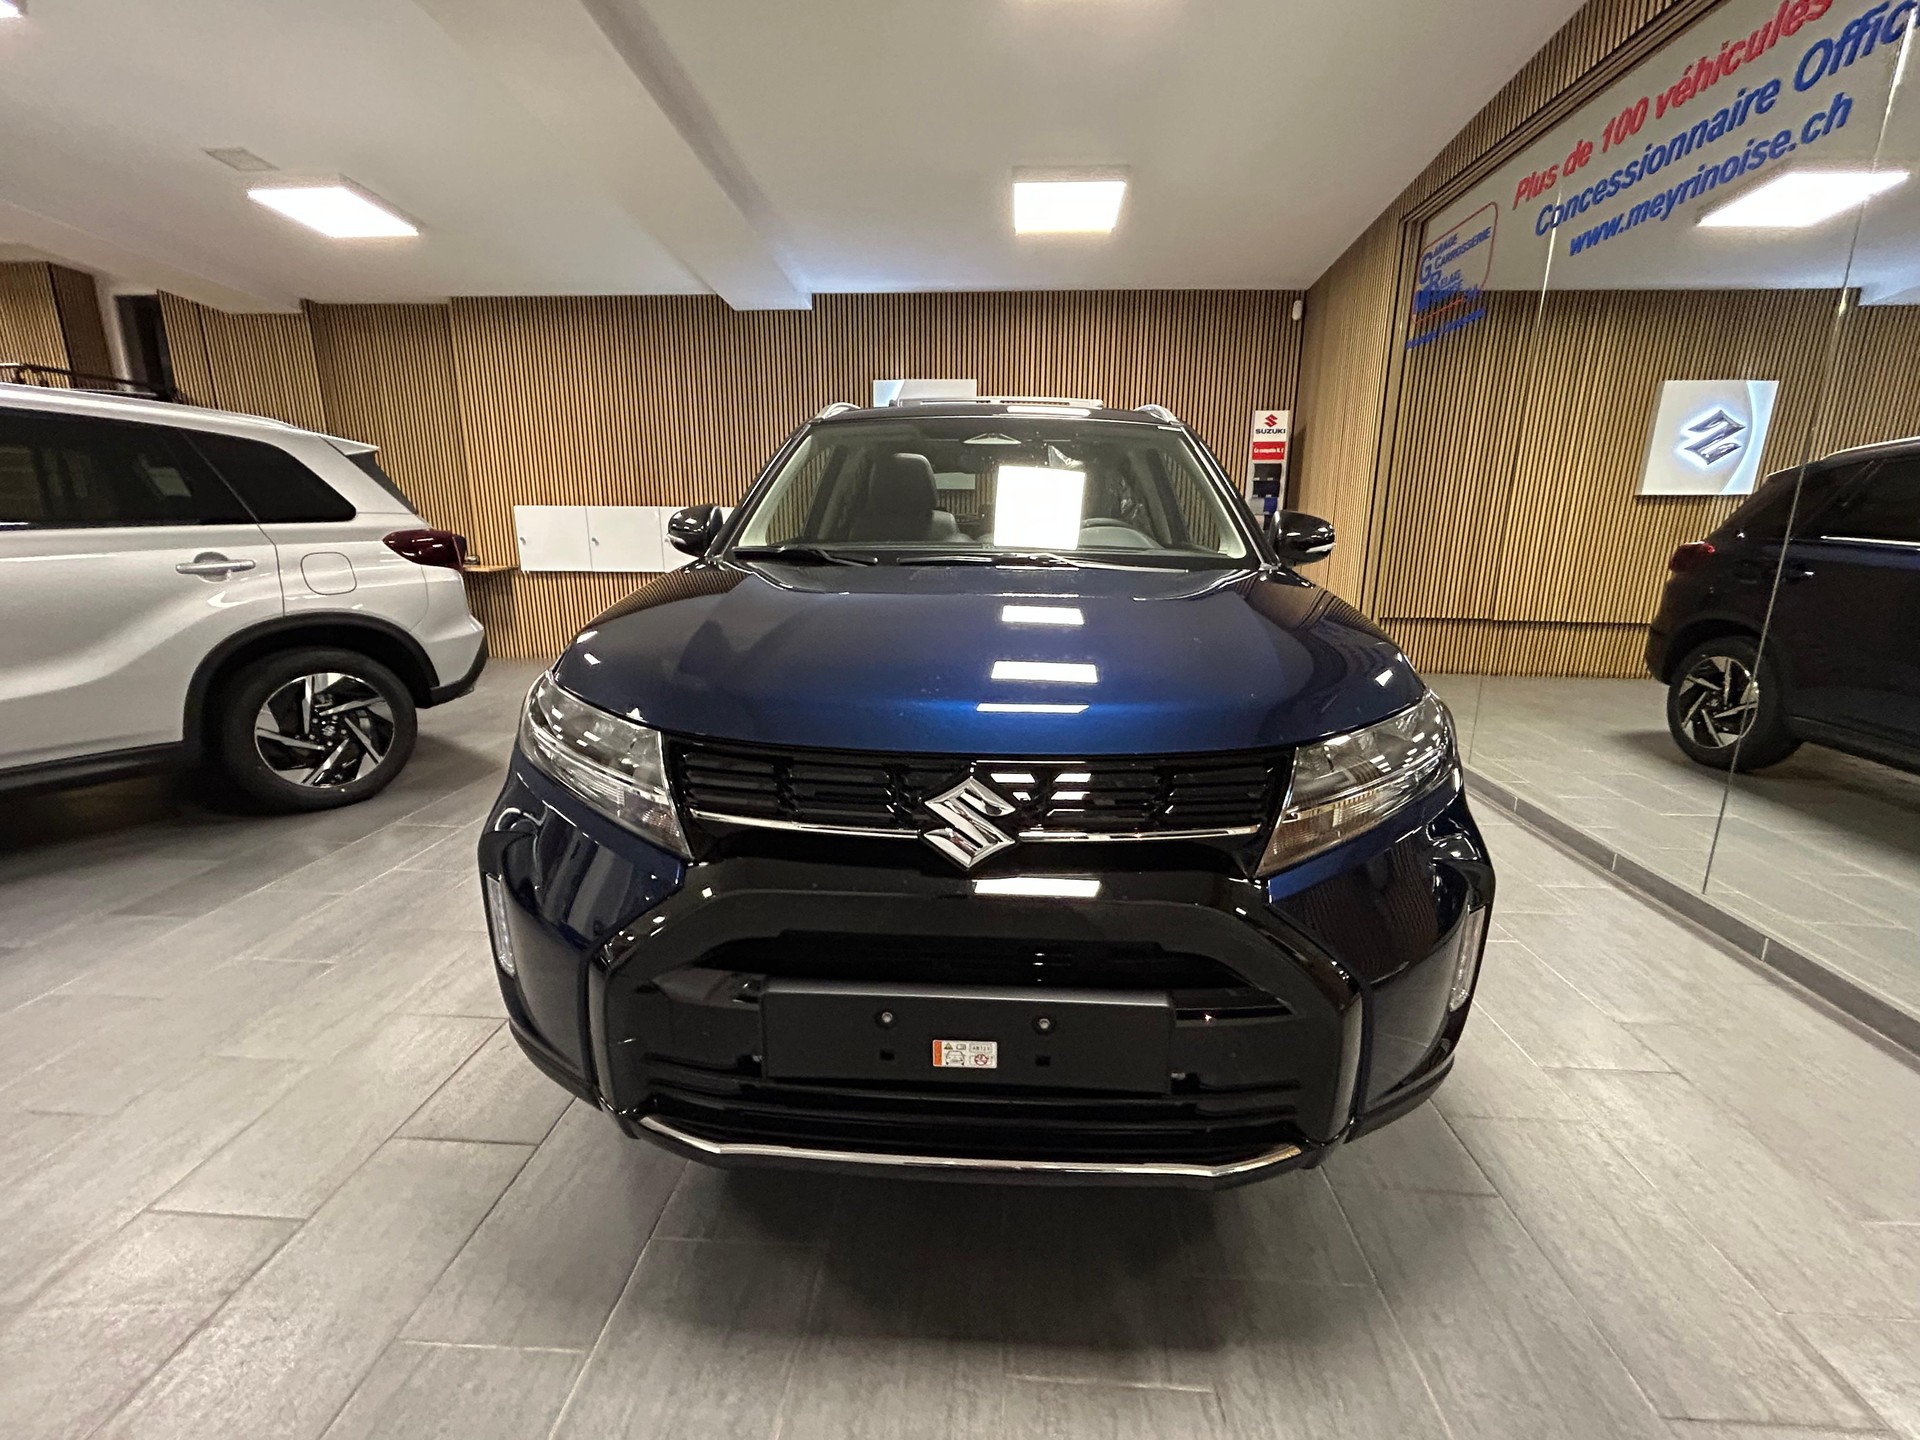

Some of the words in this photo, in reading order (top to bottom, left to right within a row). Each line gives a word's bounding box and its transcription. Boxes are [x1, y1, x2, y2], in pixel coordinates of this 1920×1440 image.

[1513, 164, 1559, 210] Plus
[1563, 139, 1593, 177] de
[1601, 97, 1649, 153] 100
[1655, 0, 1833, 119] véhicules
[1535, 78, 1781, 236] Concessionnaire
[1793, 0, 1920, 92] Offic
[1569, 92, 1853, 256] www.meyrinoise.ch
[1435, 227, 1491, 269] CARROSSERIE
